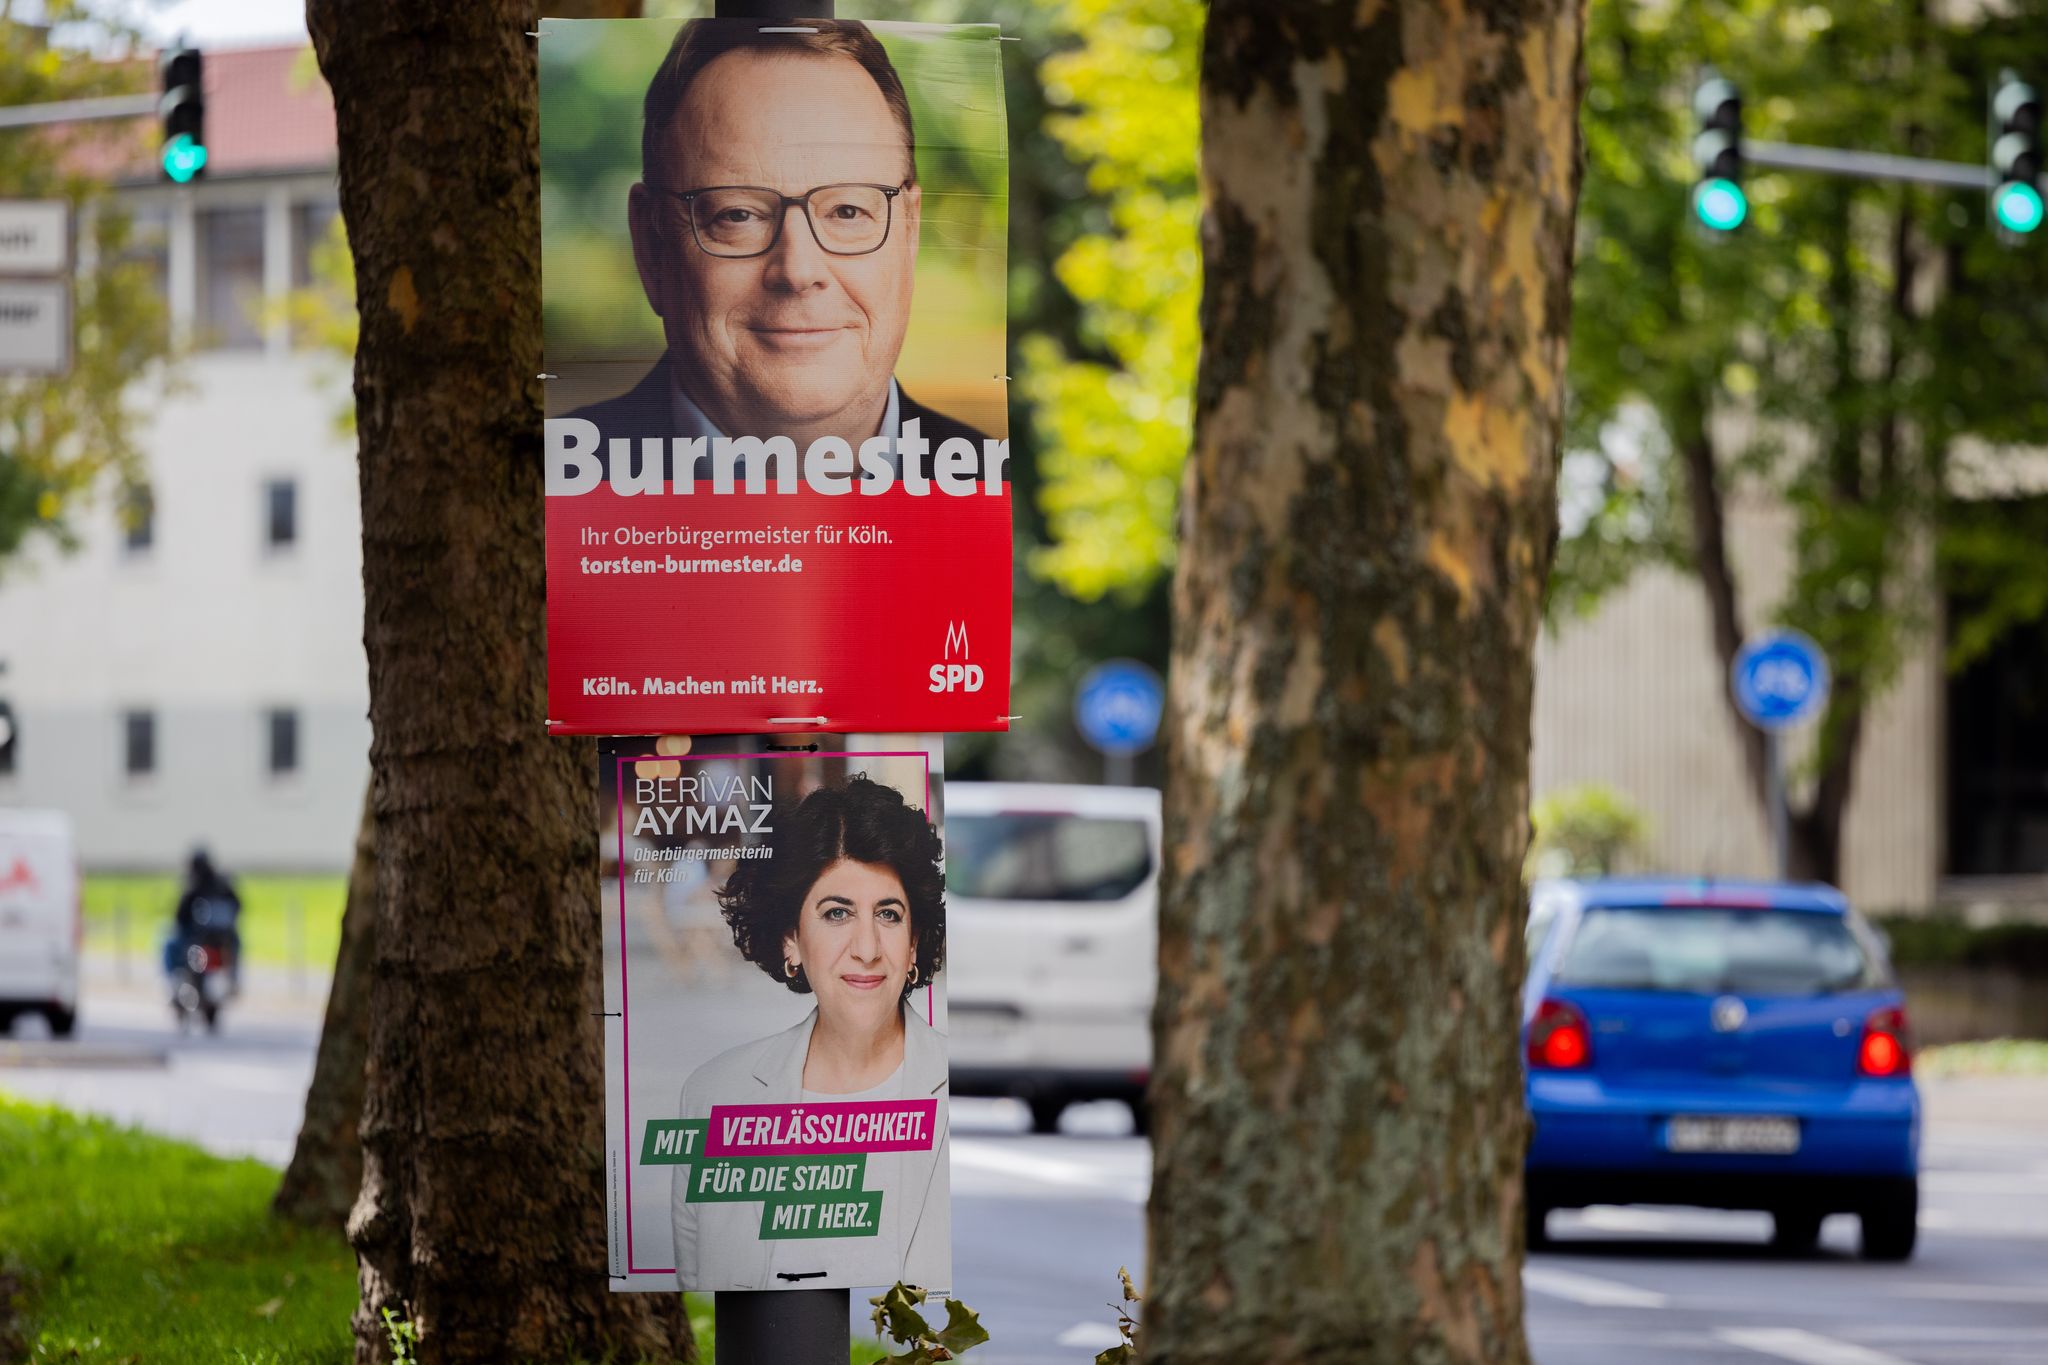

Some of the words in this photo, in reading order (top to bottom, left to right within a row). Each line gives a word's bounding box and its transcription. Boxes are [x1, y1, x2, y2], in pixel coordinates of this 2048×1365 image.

[544, 417, 1010, 497] Burmester
[580, 527, 609, 546] Ihr
[613, 525, 811, 550] Oberbürgermeister
[814, 526, 844, 544] für
[848, 525, 894, 545] Köln.
[580, 555, 803, 574] torsten-burmester.de
[582, 677, 637, 695] Köln.
[642, 676, 725, 695] Machen
[730, 676, 767, 695] mit
[770, 676, 824, 695] Herz.
[928, 664, 984, 692] SPD
[635, 770, 773, 804] BERÎVAN
[632, 804, 773, 836] AYMAZ
[632, 845, 773, 863] Oberbürgermeisterin
[633, 869, 655, 884] für
[656, 868, 687, 883] Köln
[653, 1128, 699, 1155] MIT
[722, 1109, 927, 1146] VERLÄSSLICHKEIT.
[698, 1162, 745, 1194] FÜR
[750, 1166, 790, 1192] DIE
[792, 1164, 858, 1191] STADT
[771, 1203, 816, 1231] MIT
[819, 1202, 873, 1229] HERZ.
